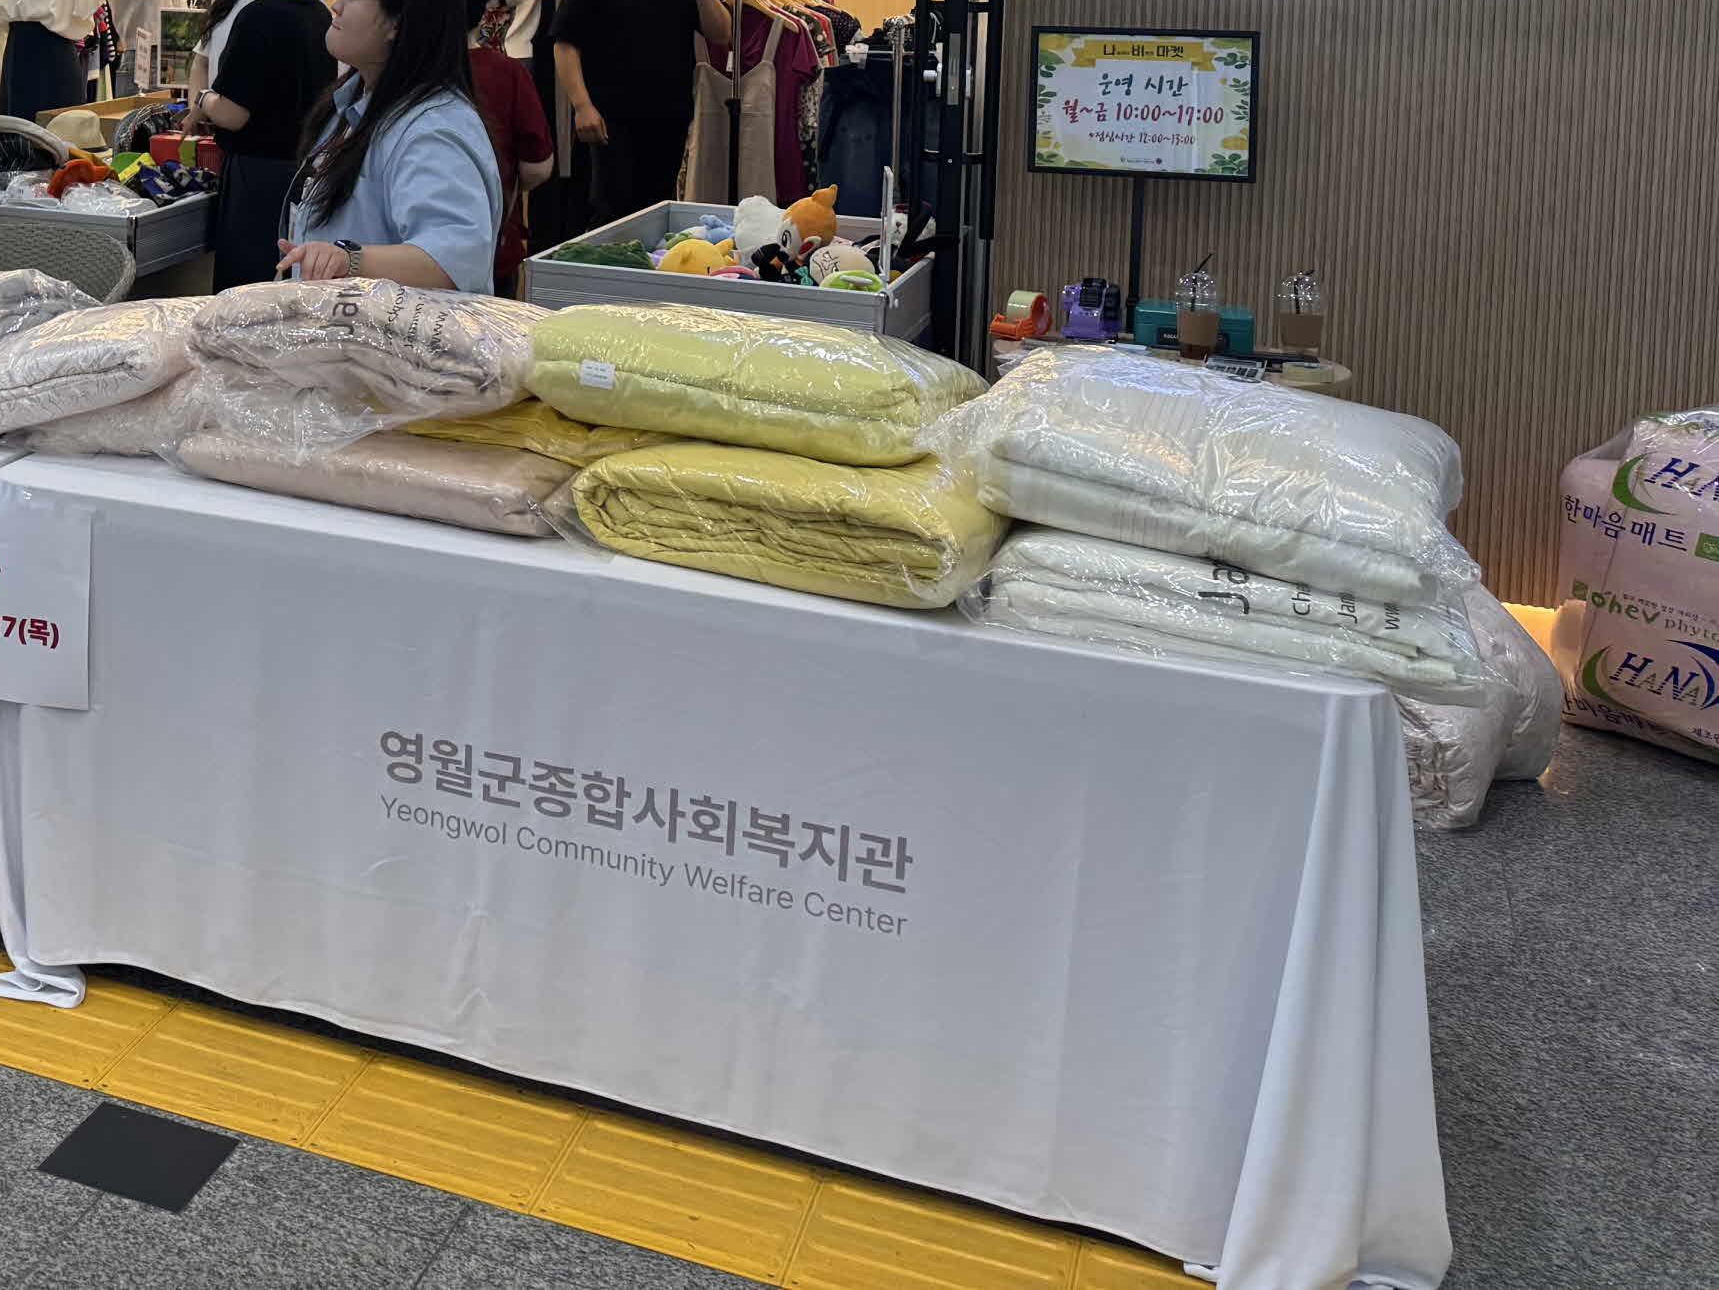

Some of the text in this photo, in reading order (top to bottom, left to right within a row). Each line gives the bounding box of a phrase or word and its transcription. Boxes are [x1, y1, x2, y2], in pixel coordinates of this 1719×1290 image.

[1098, 72, 1189, 97] 운영 시간
[1115, 102, 1224, 126] 10:00~17:00
[1609, 652, 1701, 707] HANA
[379, 730, 914, 895] 영월군종합사회복지관
[379, 794, 907, 938] Yeongwol Community Welfare Center
